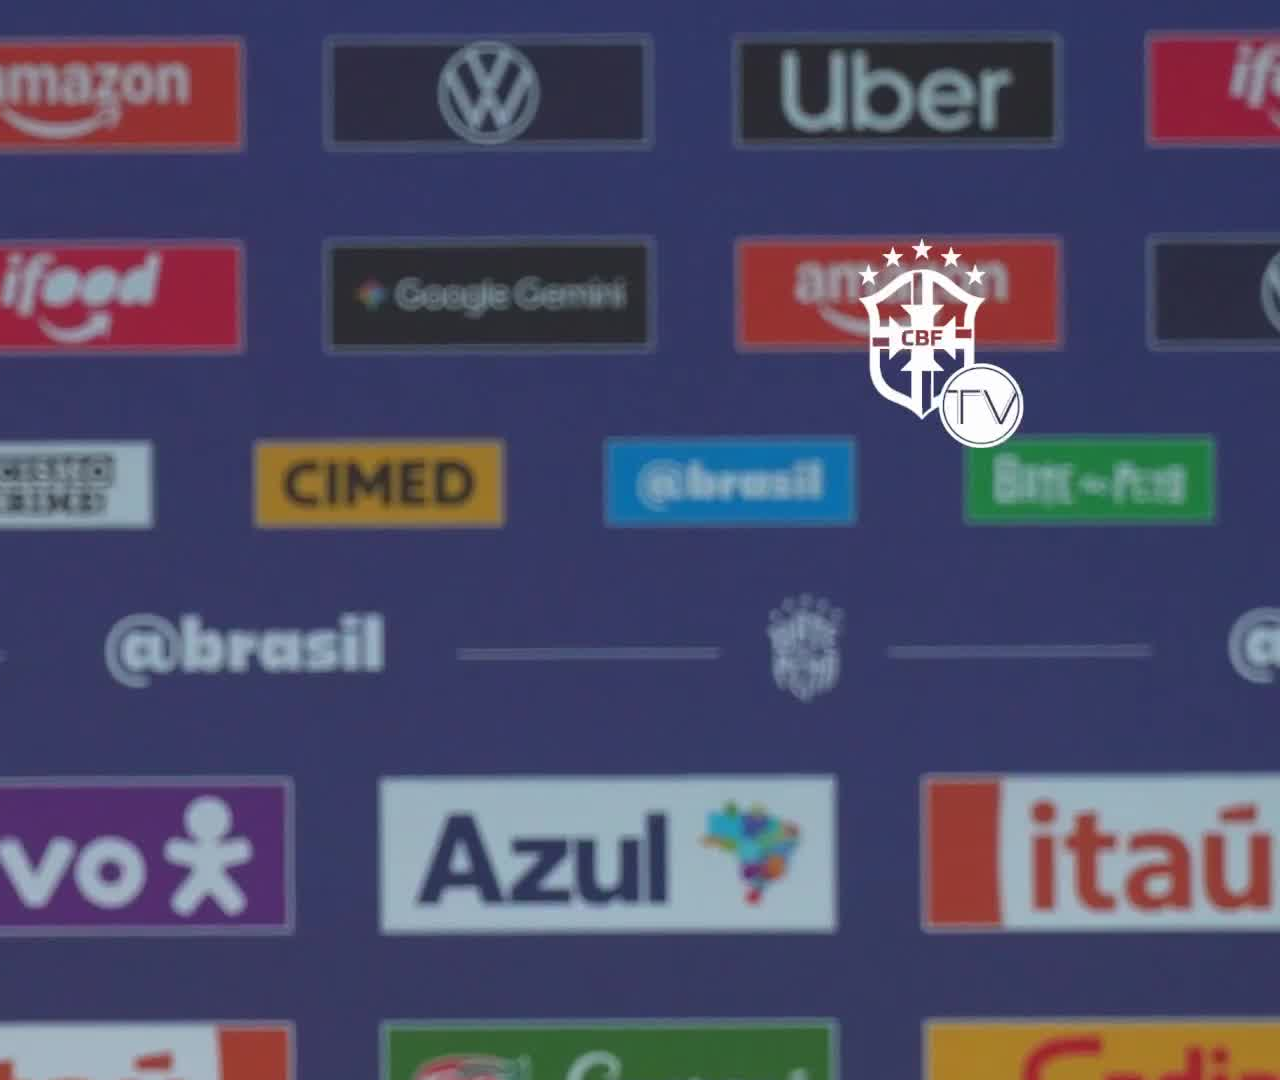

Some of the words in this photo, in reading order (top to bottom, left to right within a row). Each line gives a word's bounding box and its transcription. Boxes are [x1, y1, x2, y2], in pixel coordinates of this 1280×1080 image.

[783, 52, 1012, 133] Uber
[2, 254, 161, 320] ifood
[396, 279, 509, 318] Google
[514, 278, 627, 311] Gemini
[284, 461, 476, 509] CIMED
[639, 461, 825, 510] @brasil
[107, 615, 385, 688] @brasil
[419, 813, 669, 907] Azul
[1033, 803, 1273, 912] itaú
